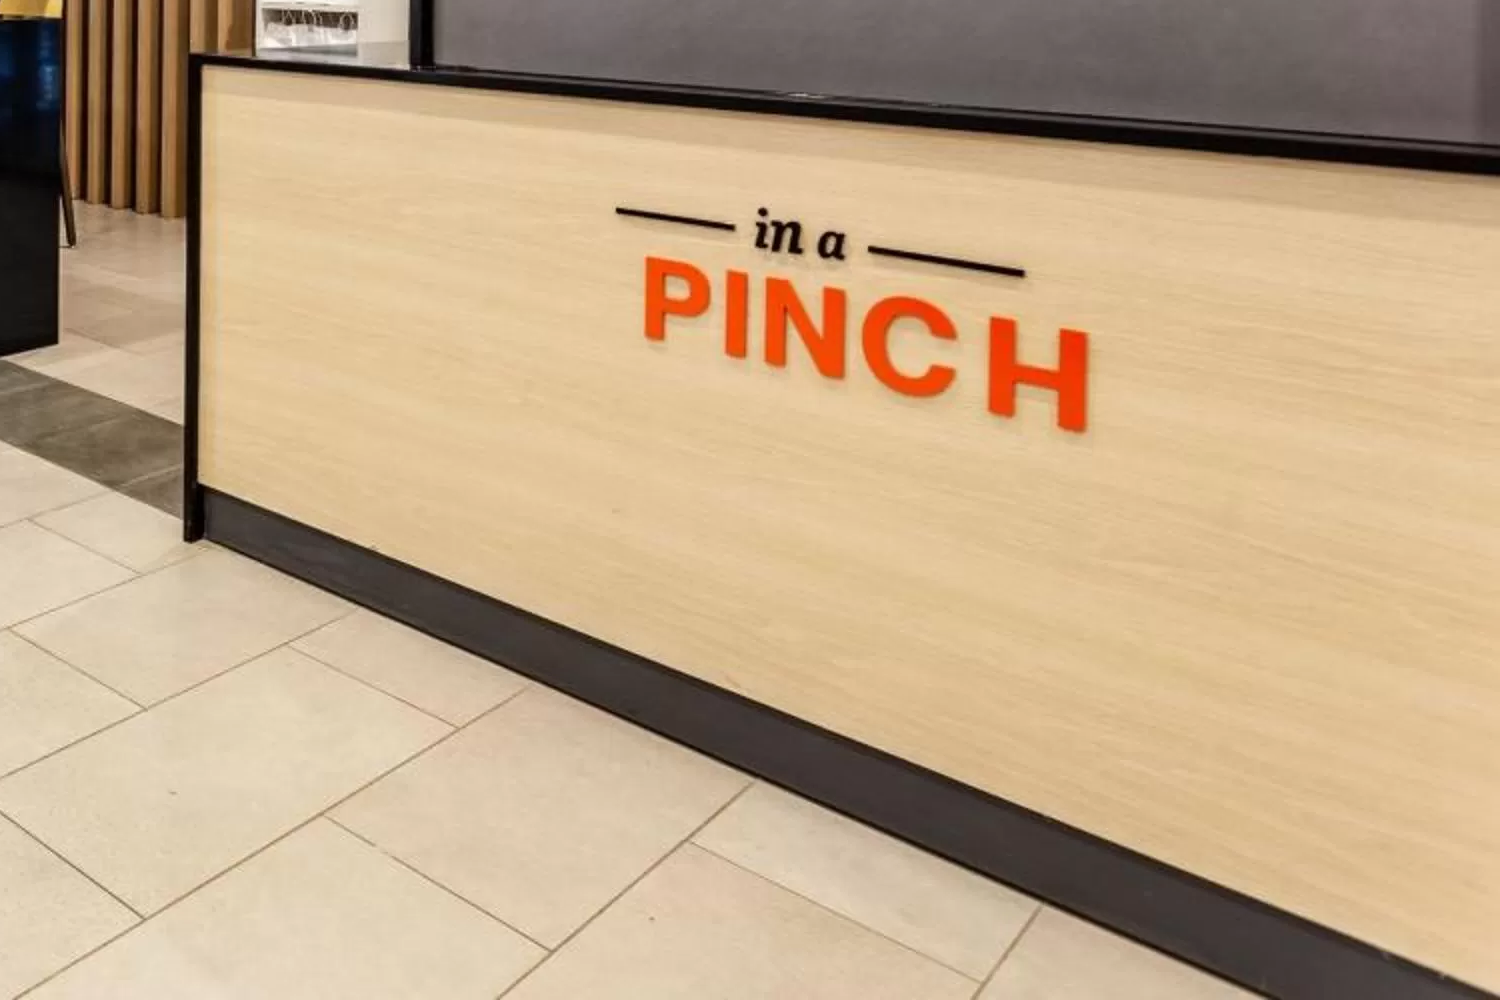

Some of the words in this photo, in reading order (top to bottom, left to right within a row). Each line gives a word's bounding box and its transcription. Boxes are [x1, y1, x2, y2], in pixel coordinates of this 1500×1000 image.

[754, 207, 804, 255] in
[817, 229, 847, 261] a
[644, 255, 1089, 434] PINCH
